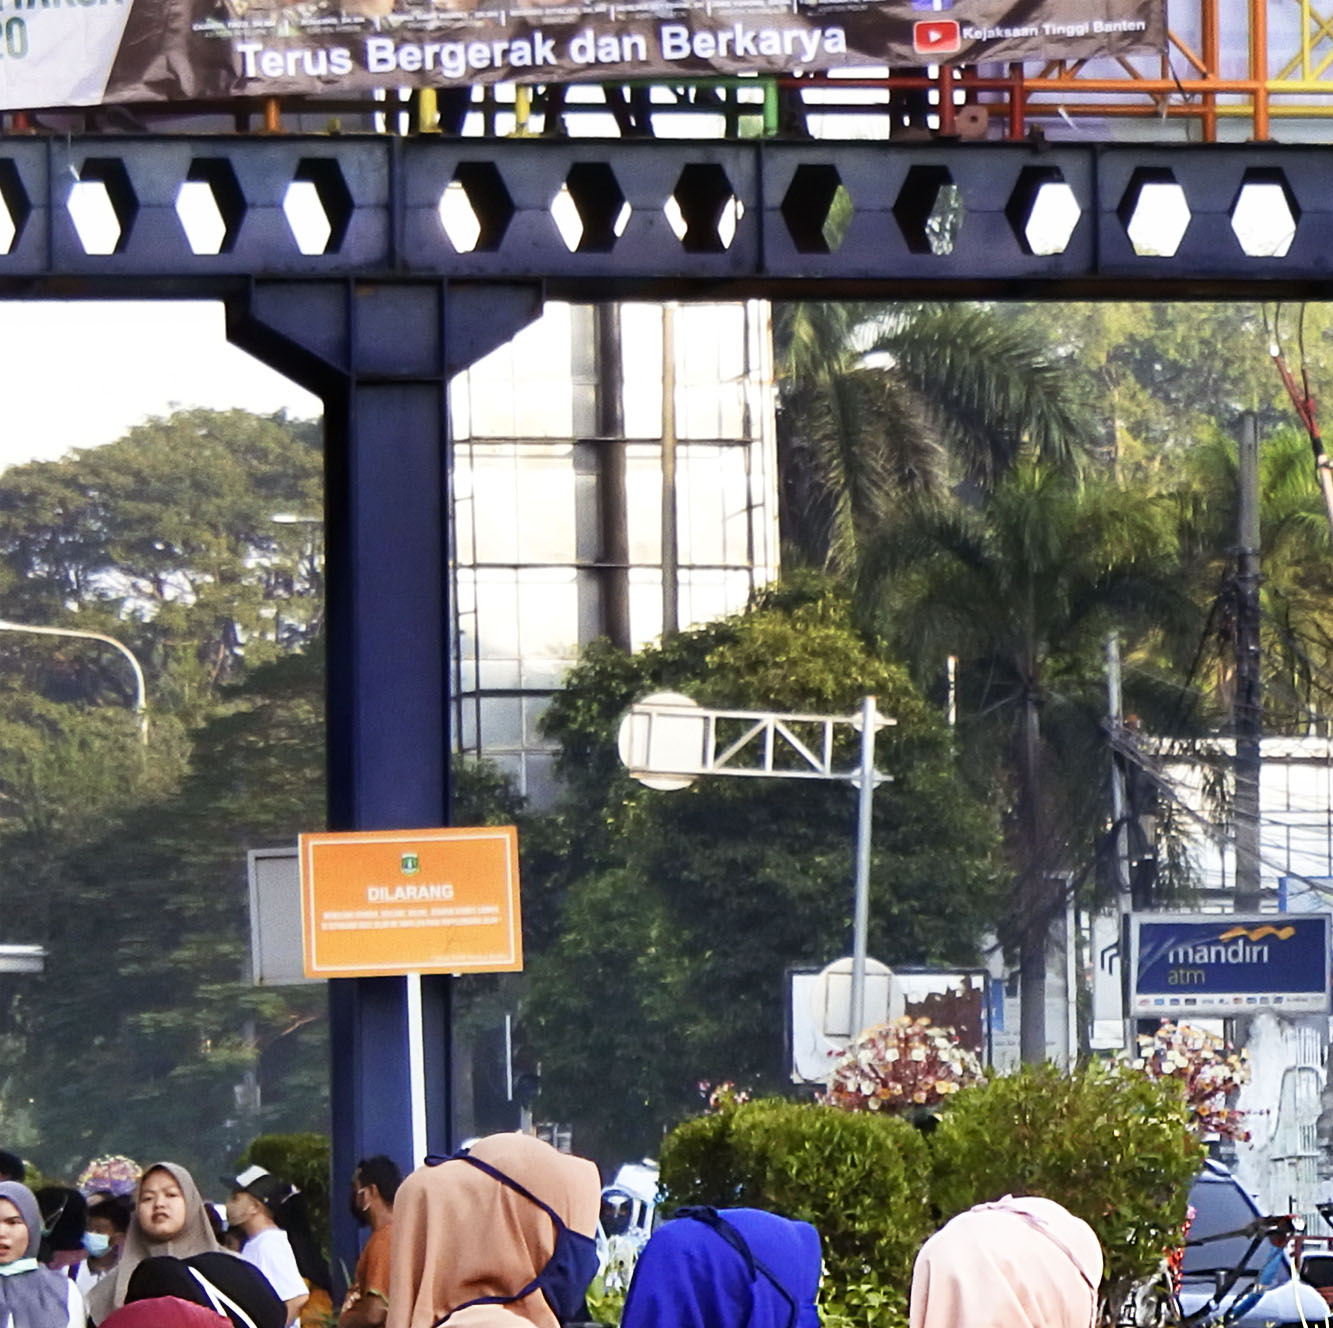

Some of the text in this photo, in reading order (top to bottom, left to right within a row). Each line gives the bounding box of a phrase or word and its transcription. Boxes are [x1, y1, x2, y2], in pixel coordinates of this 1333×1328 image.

[963, 21, 1146, 41] Kejaksaan Tinggi Banten
[236, 23, 847, 79] Terus Bergerak dan Berkarya
[367, 884, 454, 902] DILARANG
[1168, 939, 1269, 964] mandiri
[1168, 968, 1206, 985] atm
